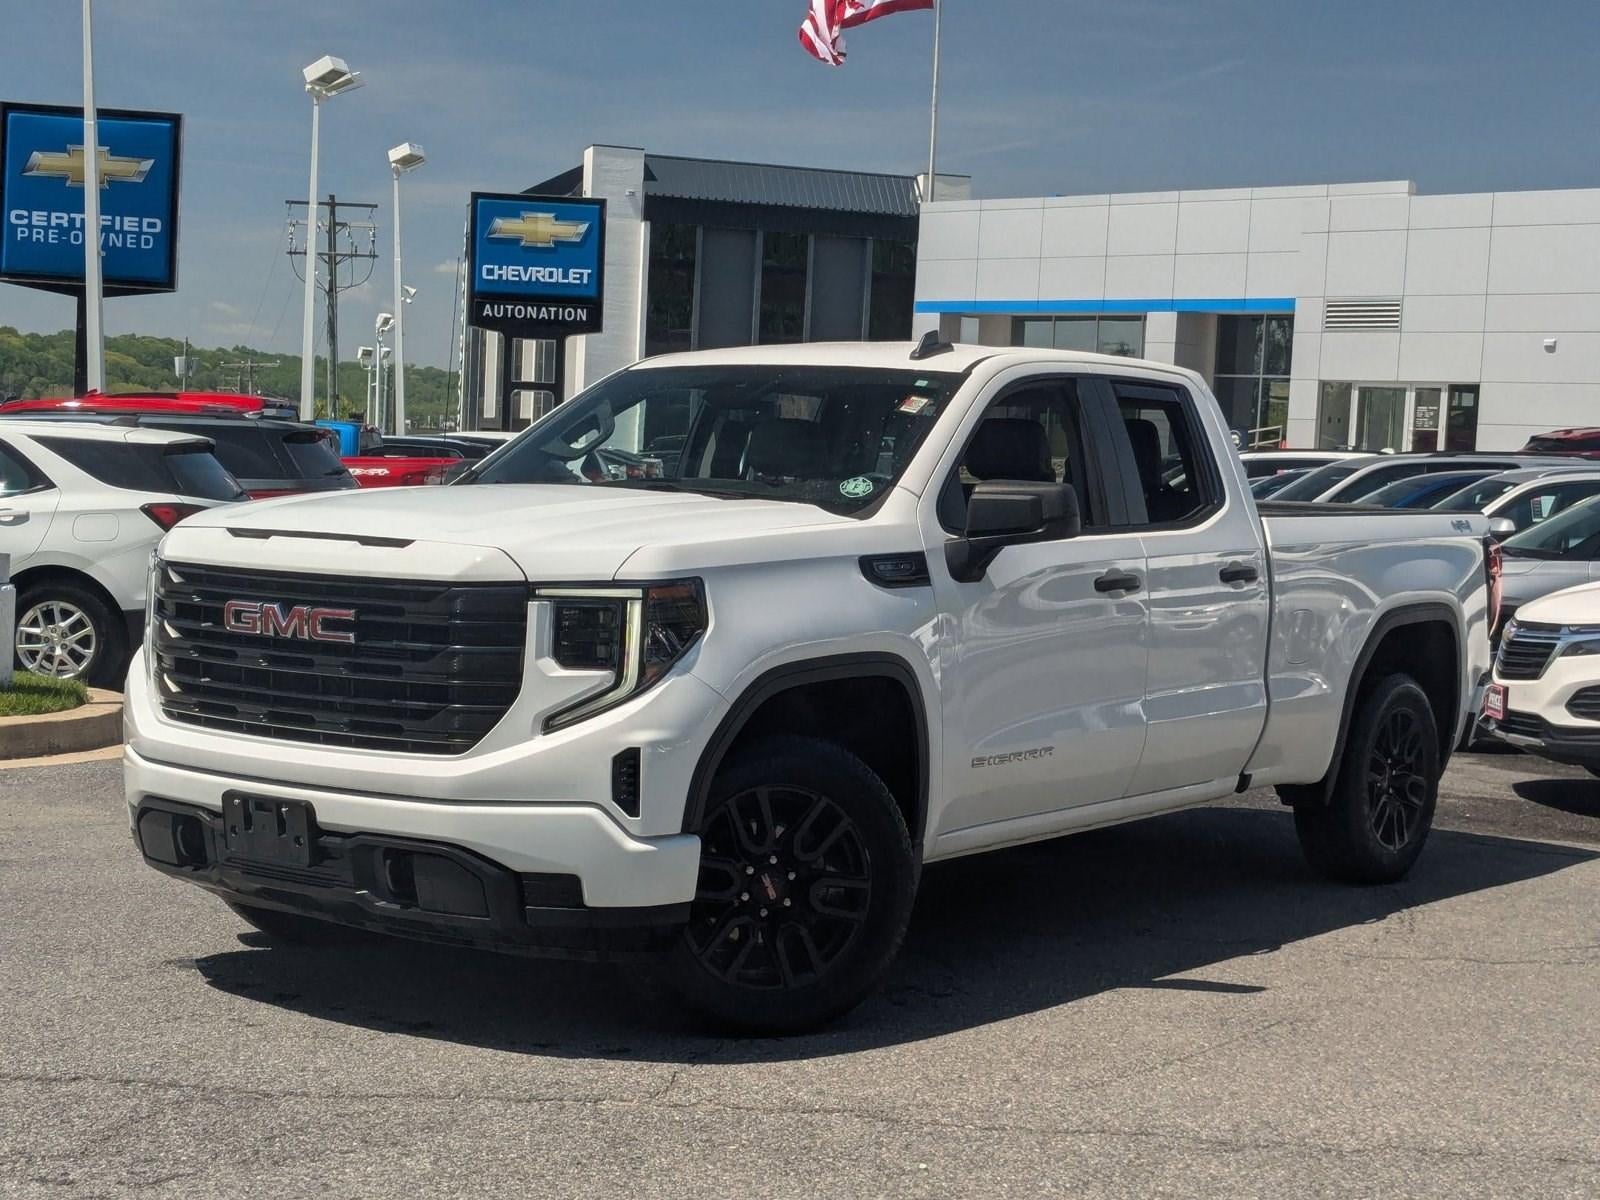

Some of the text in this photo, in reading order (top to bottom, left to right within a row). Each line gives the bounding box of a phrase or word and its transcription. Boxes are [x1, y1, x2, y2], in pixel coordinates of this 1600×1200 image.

[10, 209, 162, 234] CERTFIED
[482, 264, 592, 284] CHEVROLET
[483, 303, 587, 321] AUTONATION
[224, 600, 356, 644] GMC
[970, 745, 1055, 769] SIERRA
